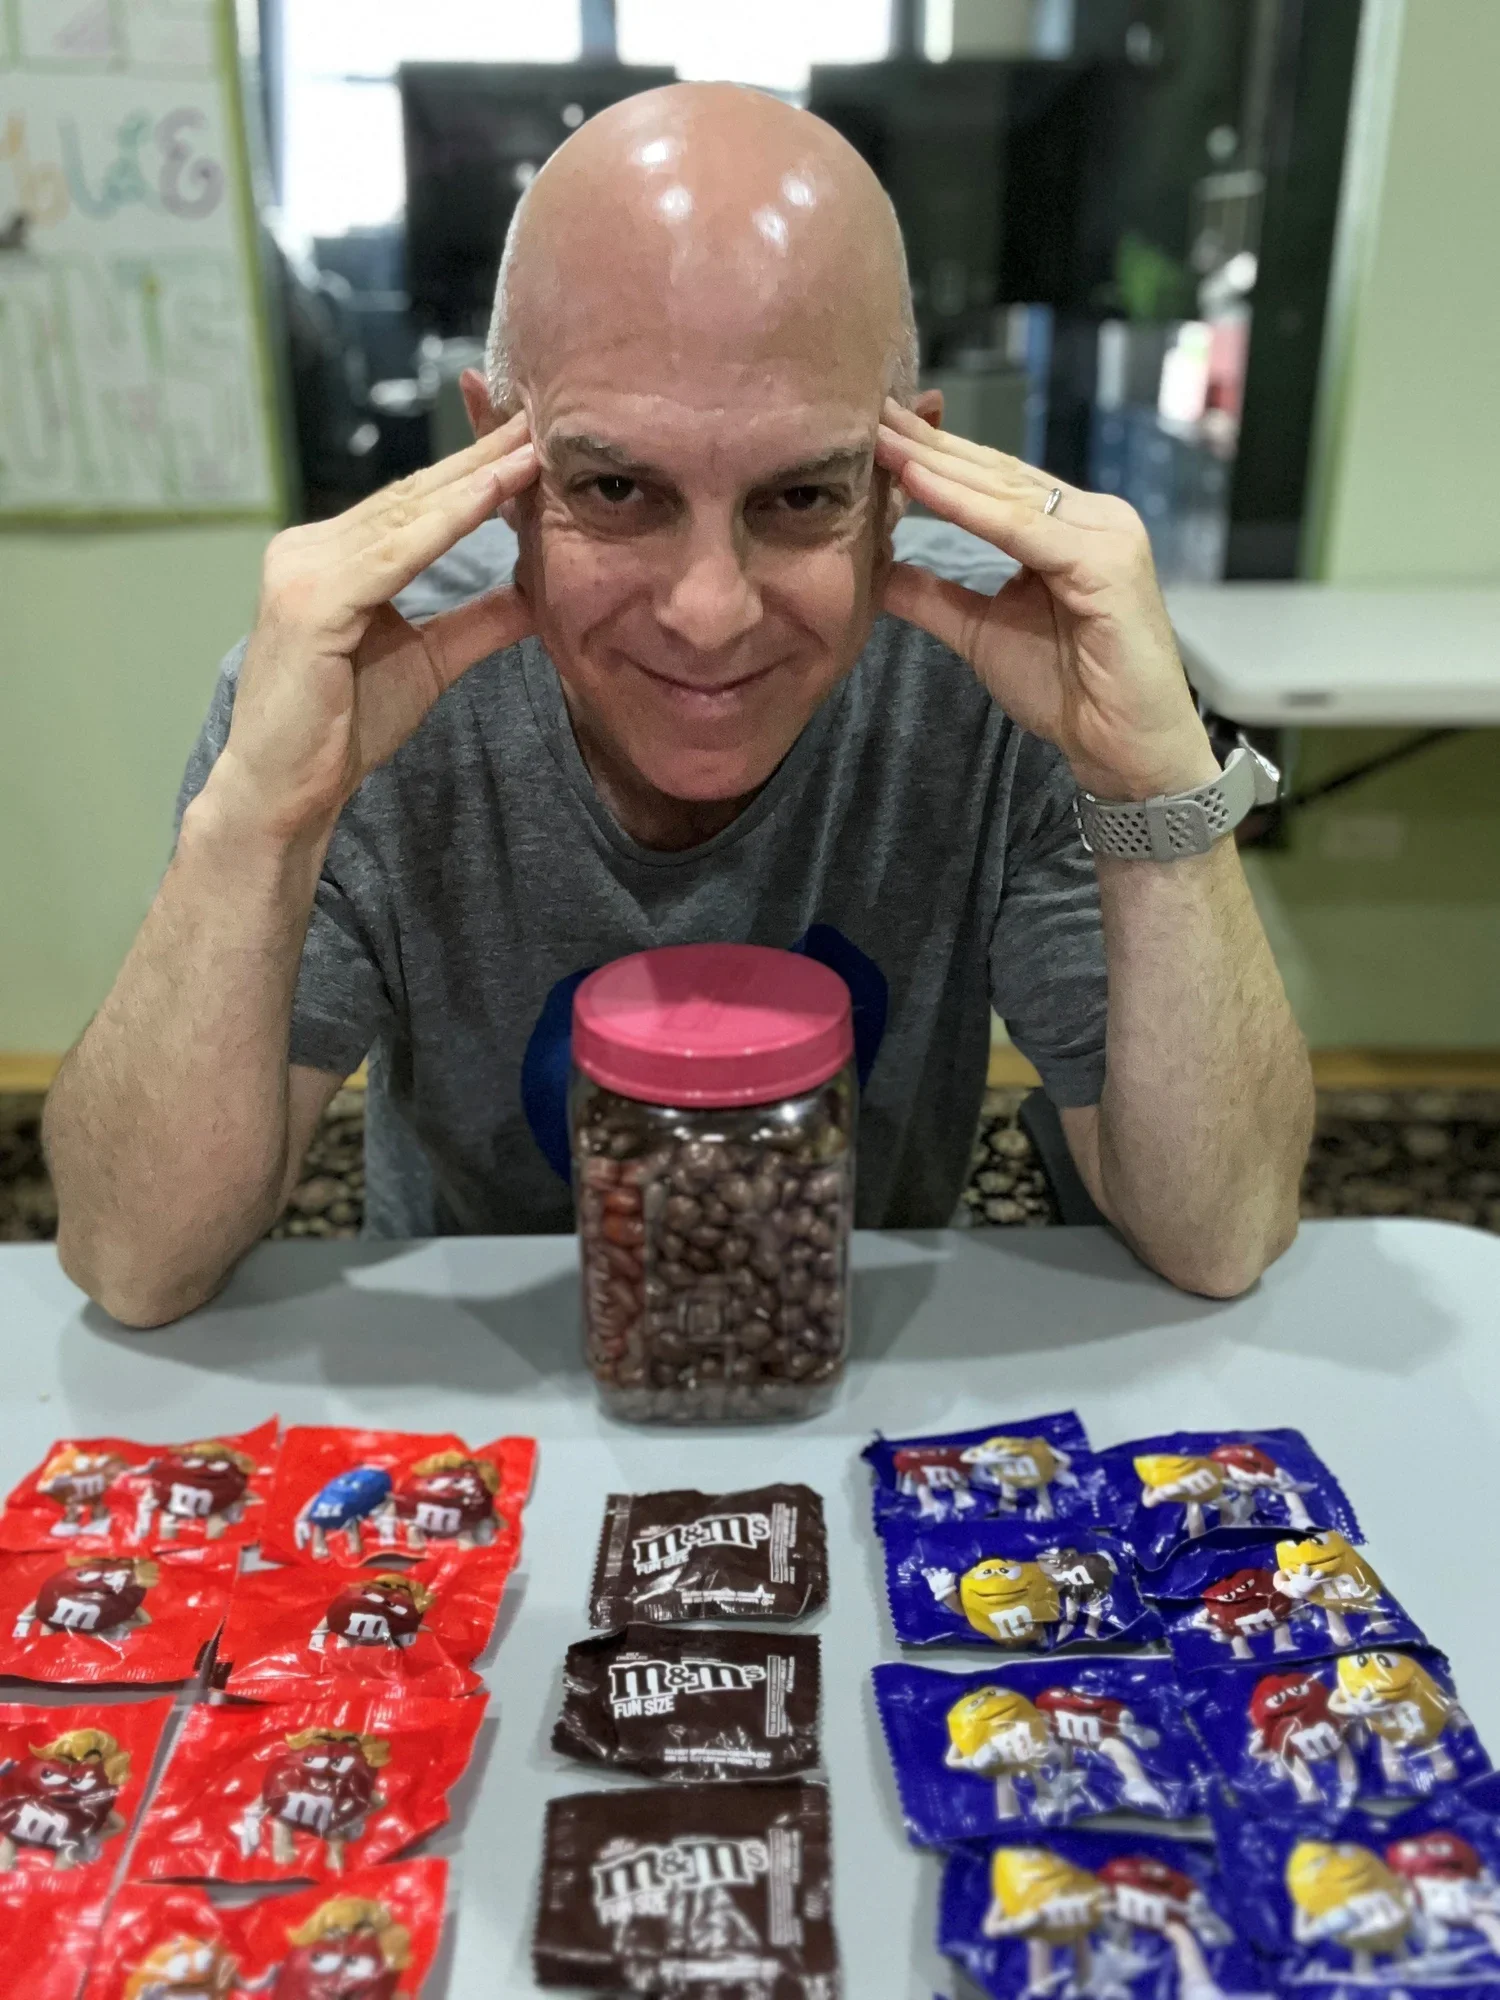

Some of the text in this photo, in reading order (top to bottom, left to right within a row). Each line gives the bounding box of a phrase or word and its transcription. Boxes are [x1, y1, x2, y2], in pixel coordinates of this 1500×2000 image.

[49, 1598, 100, 1629] m
[344, 1613, 390, 1639] m
[614, 1695, 676, 1719] FUN SIZE
[1055, 1710, 1100, 1743] m
[1290, 1722, 1342, 1760] m
[11, 1804, 68, 1845] m
[282, 1791, 332, 1830] m
